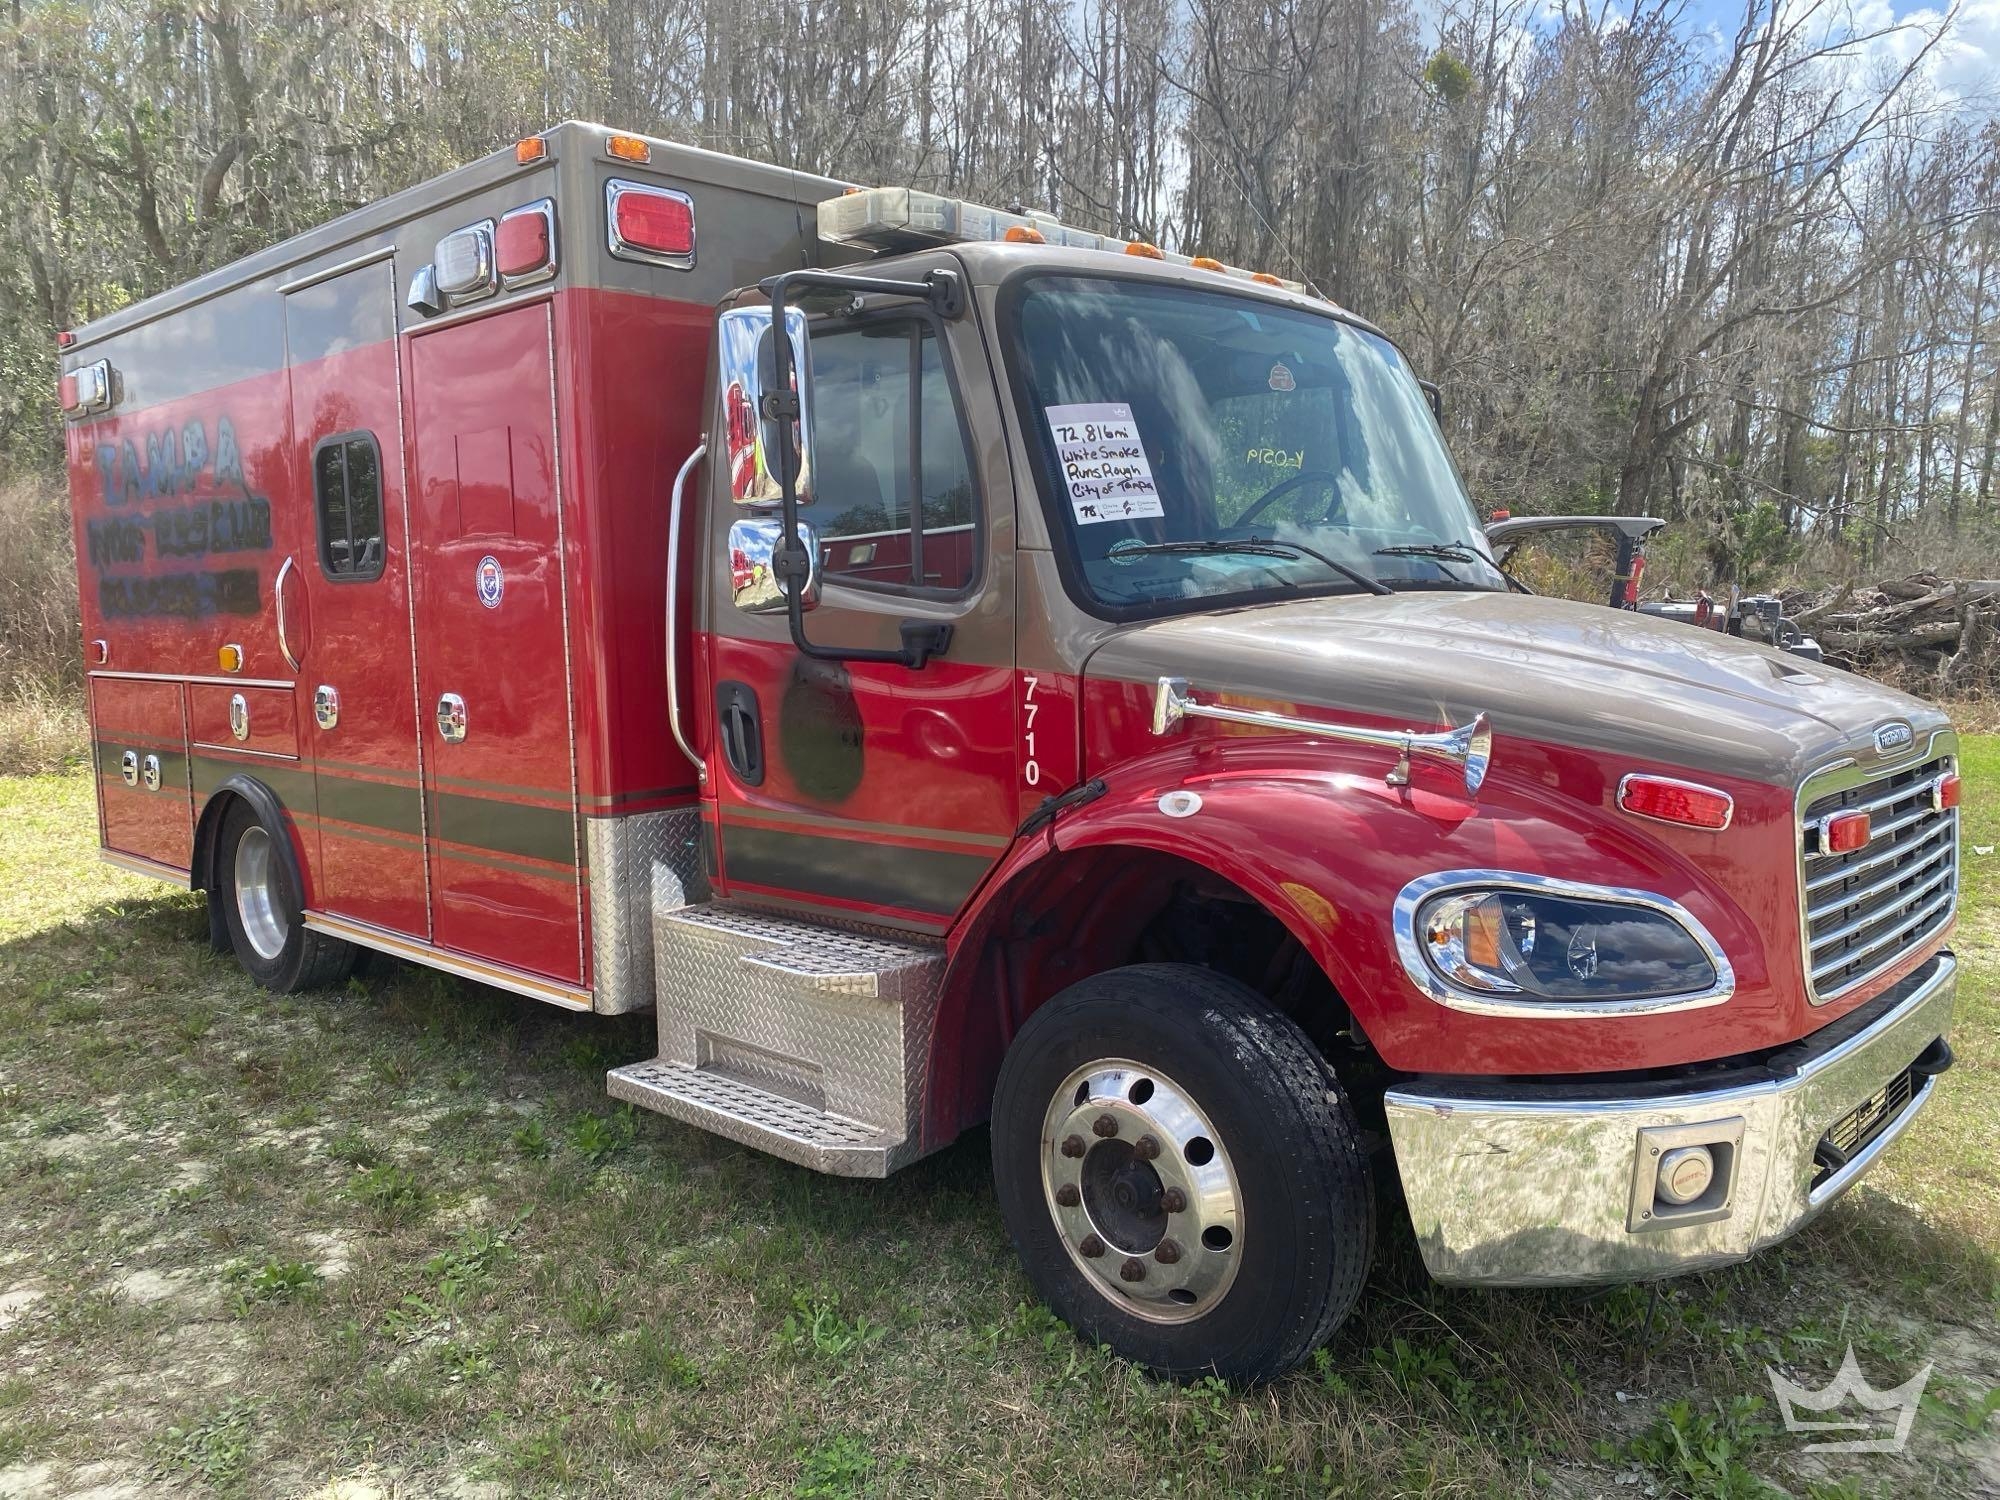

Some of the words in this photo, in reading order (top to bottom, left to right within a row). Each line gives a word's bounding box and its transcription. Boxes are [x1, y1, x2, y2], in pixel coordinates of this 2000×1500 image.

[1062, 447, 1098, 463] White
[1099, 446, 1140, 459] Smoke
[1067, 463, 1102, 481] Runs
[1101, 463, 1141, 481] Rough
[1072, 483, 1101, 500] City
[1102, 482, 1114, 495] of
[1116, 479, 1154, 493] Tampa
[1023, 676, 1039, 785] 7710
